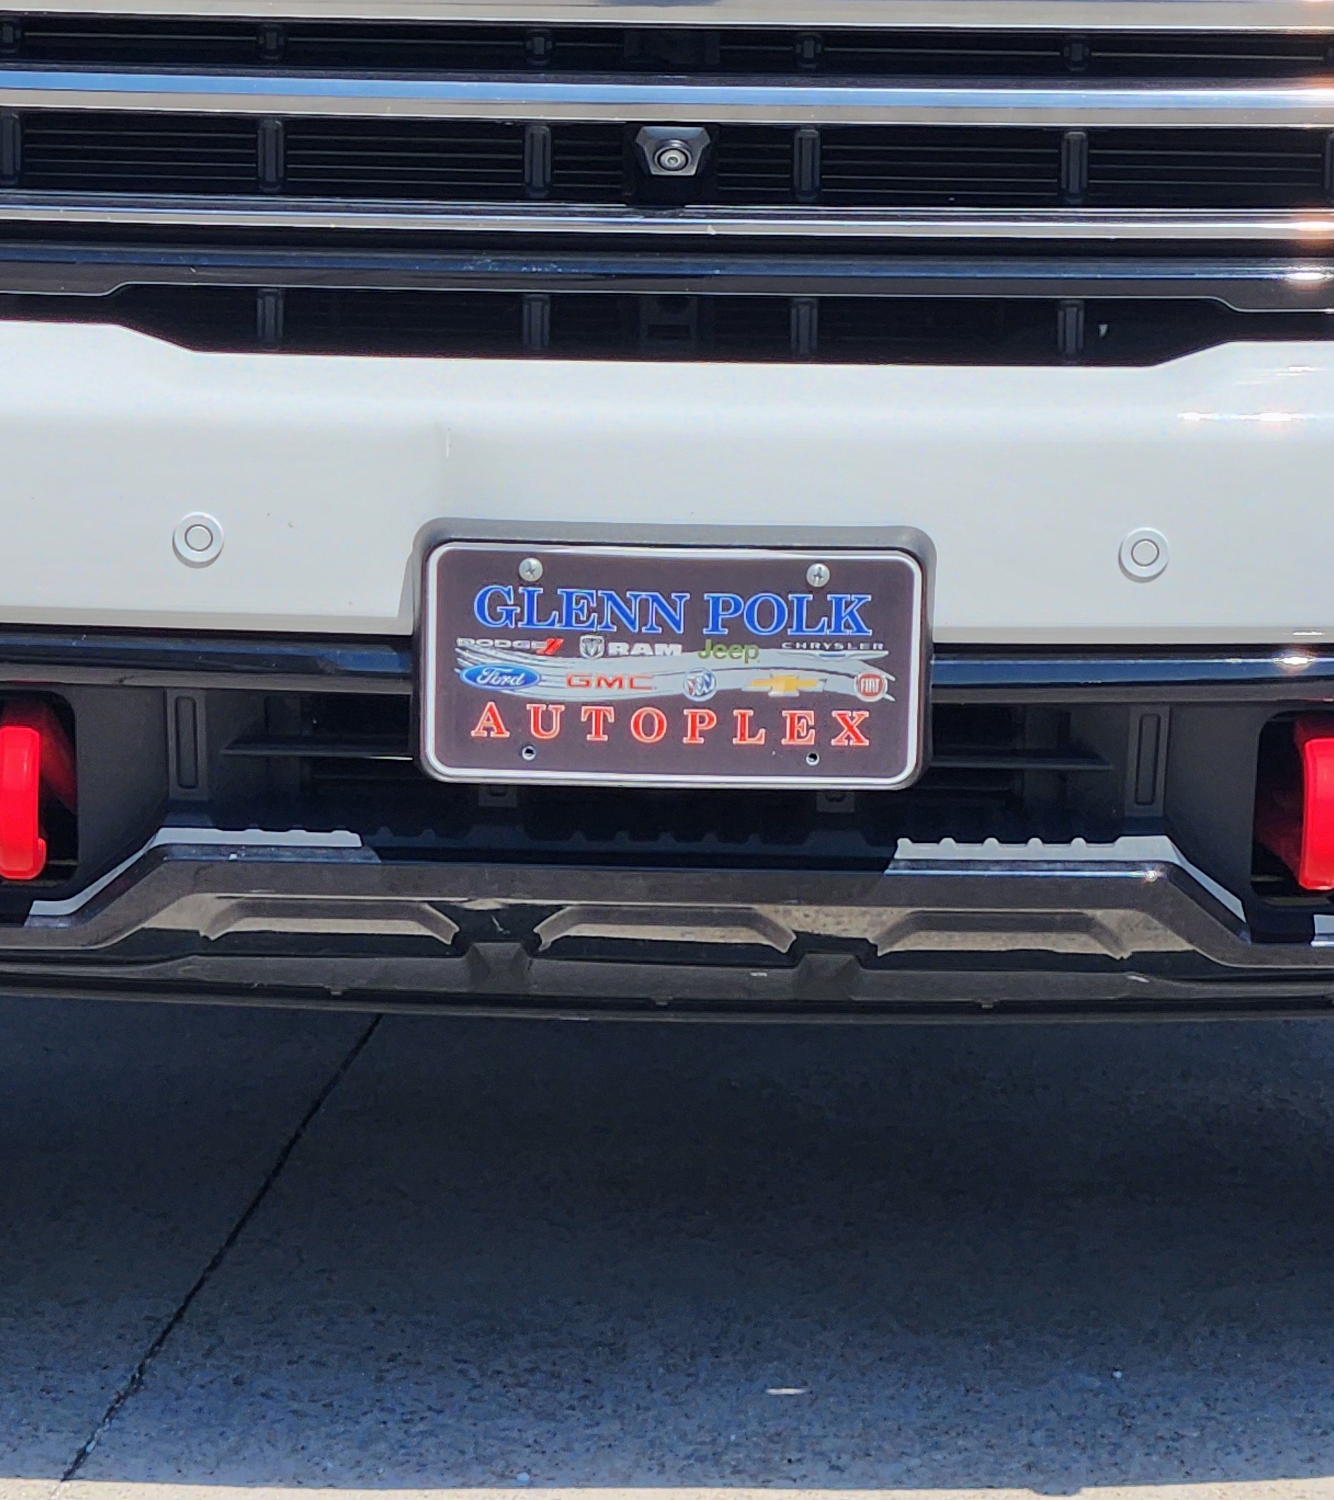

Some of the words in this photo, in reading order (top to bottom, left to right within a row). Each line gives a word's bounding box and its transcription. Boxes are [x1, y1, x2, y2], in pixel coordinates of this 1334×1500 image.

[473, 584, 690, 636] GLENN
[703, 592, 872, 637] POLK
[456, 638, 547, 649] DODGE
[608, 642, 683, 657] RAM
[697, 639, 760, 663] Jeep
[781, 642, 884, 650] CHRYSLER
[567, 673, 654, 691] GMC
[860, 678, 881, 694] FIAT
[471, 702, 870, 747] AUTOPLEX
